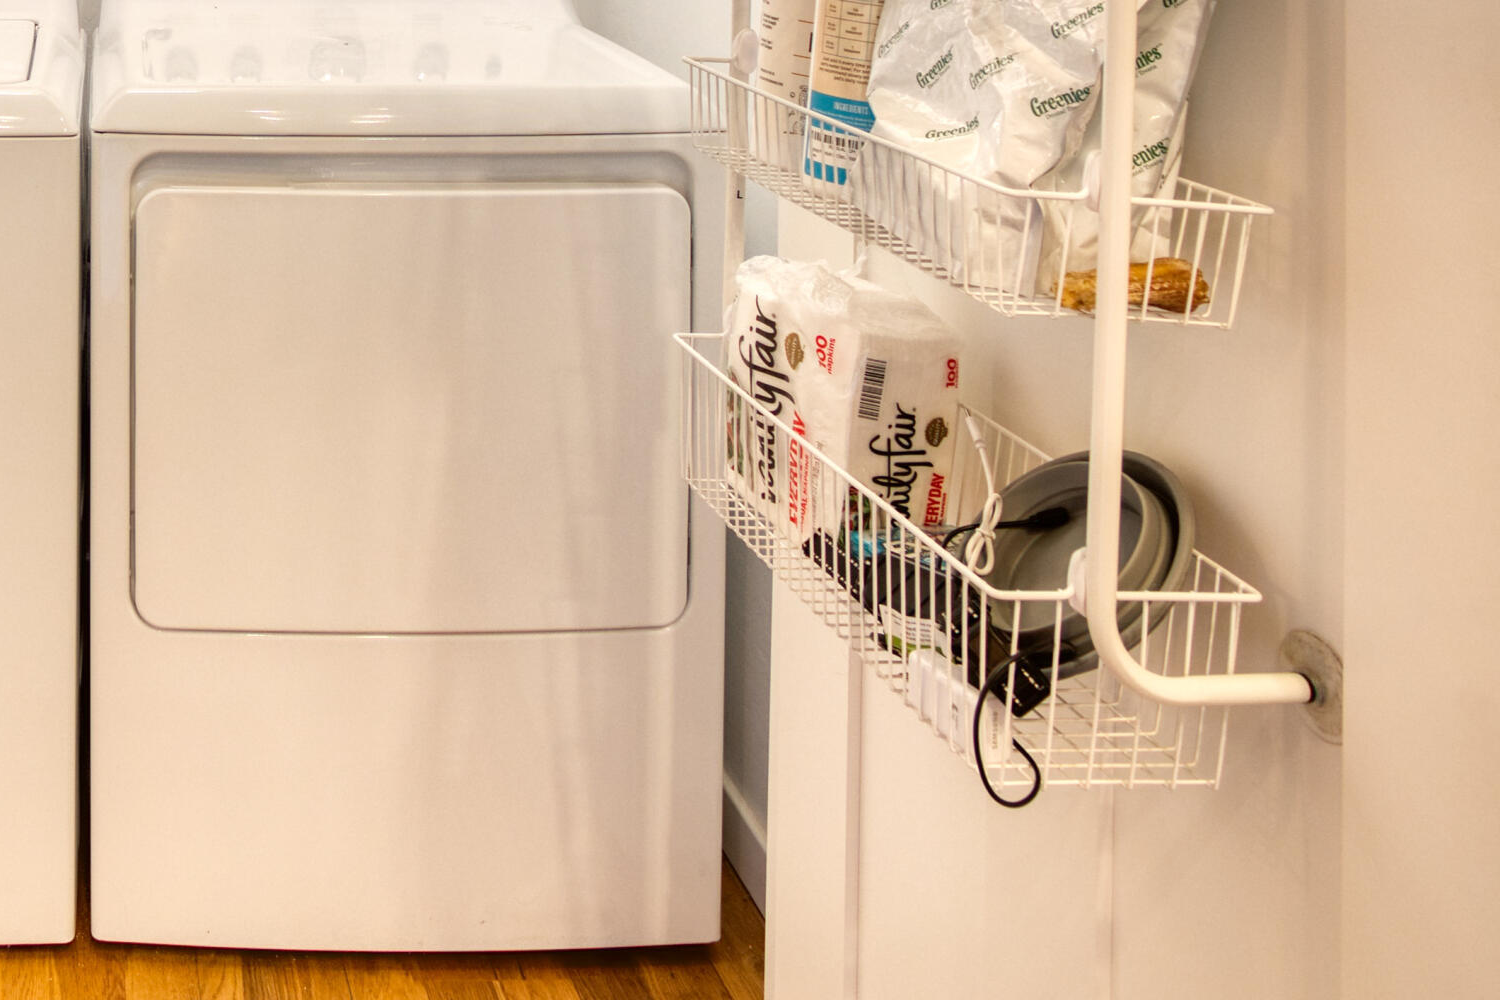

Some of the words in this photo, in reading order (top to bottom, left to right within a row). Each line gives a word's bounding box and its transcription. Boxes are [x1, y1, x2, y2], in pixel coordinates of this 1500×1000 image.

[1051, 2, 1105, 39] Greenies
[916, 49, 954, 89] Greenies
[1030, 85, 1092, 118] Greenies
[925, 116, 980, 140] Greenies
[815, 335, 828, 368] 100
[826, 337, 836, 375] napkins
[946, 358, 958, 389] 100
